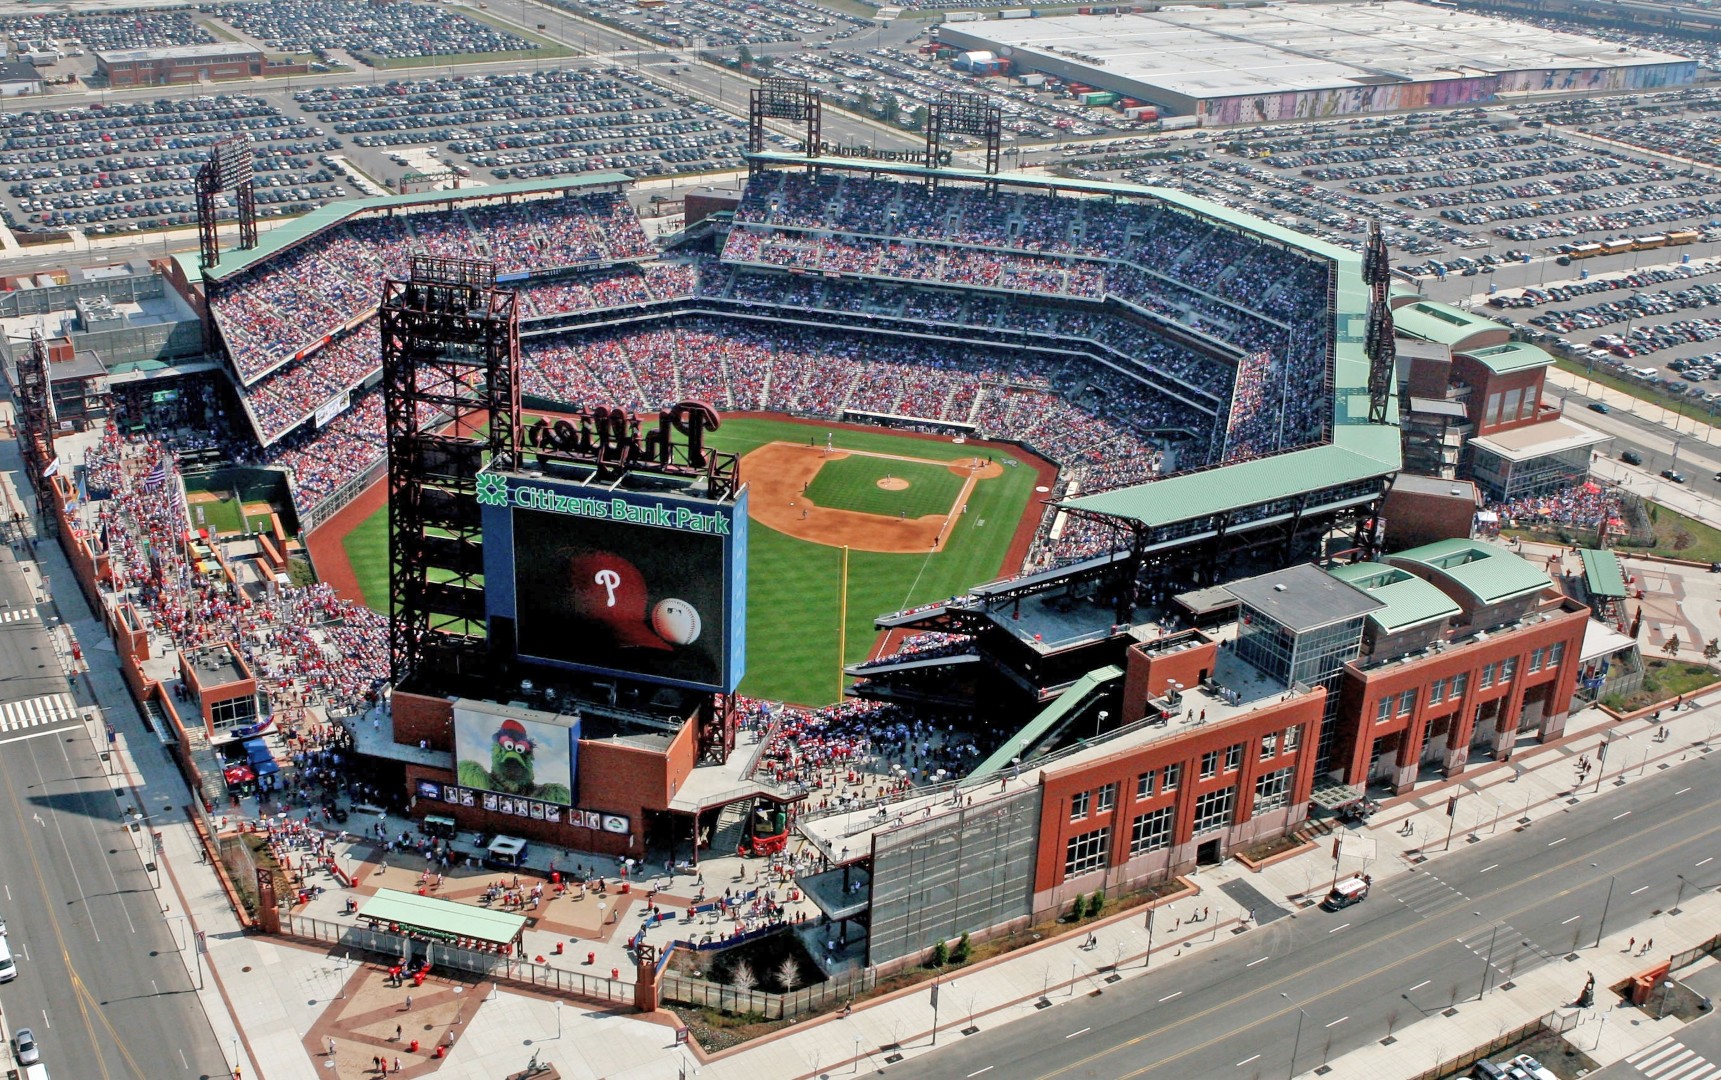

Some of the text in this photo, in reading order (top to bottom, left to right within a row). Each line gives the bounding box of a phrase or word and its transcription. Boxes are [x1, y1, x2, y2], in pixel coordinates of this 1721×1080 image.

[514, 486, 730, 535] Citizens Bank Park
[594, 569, 621, 607] P
